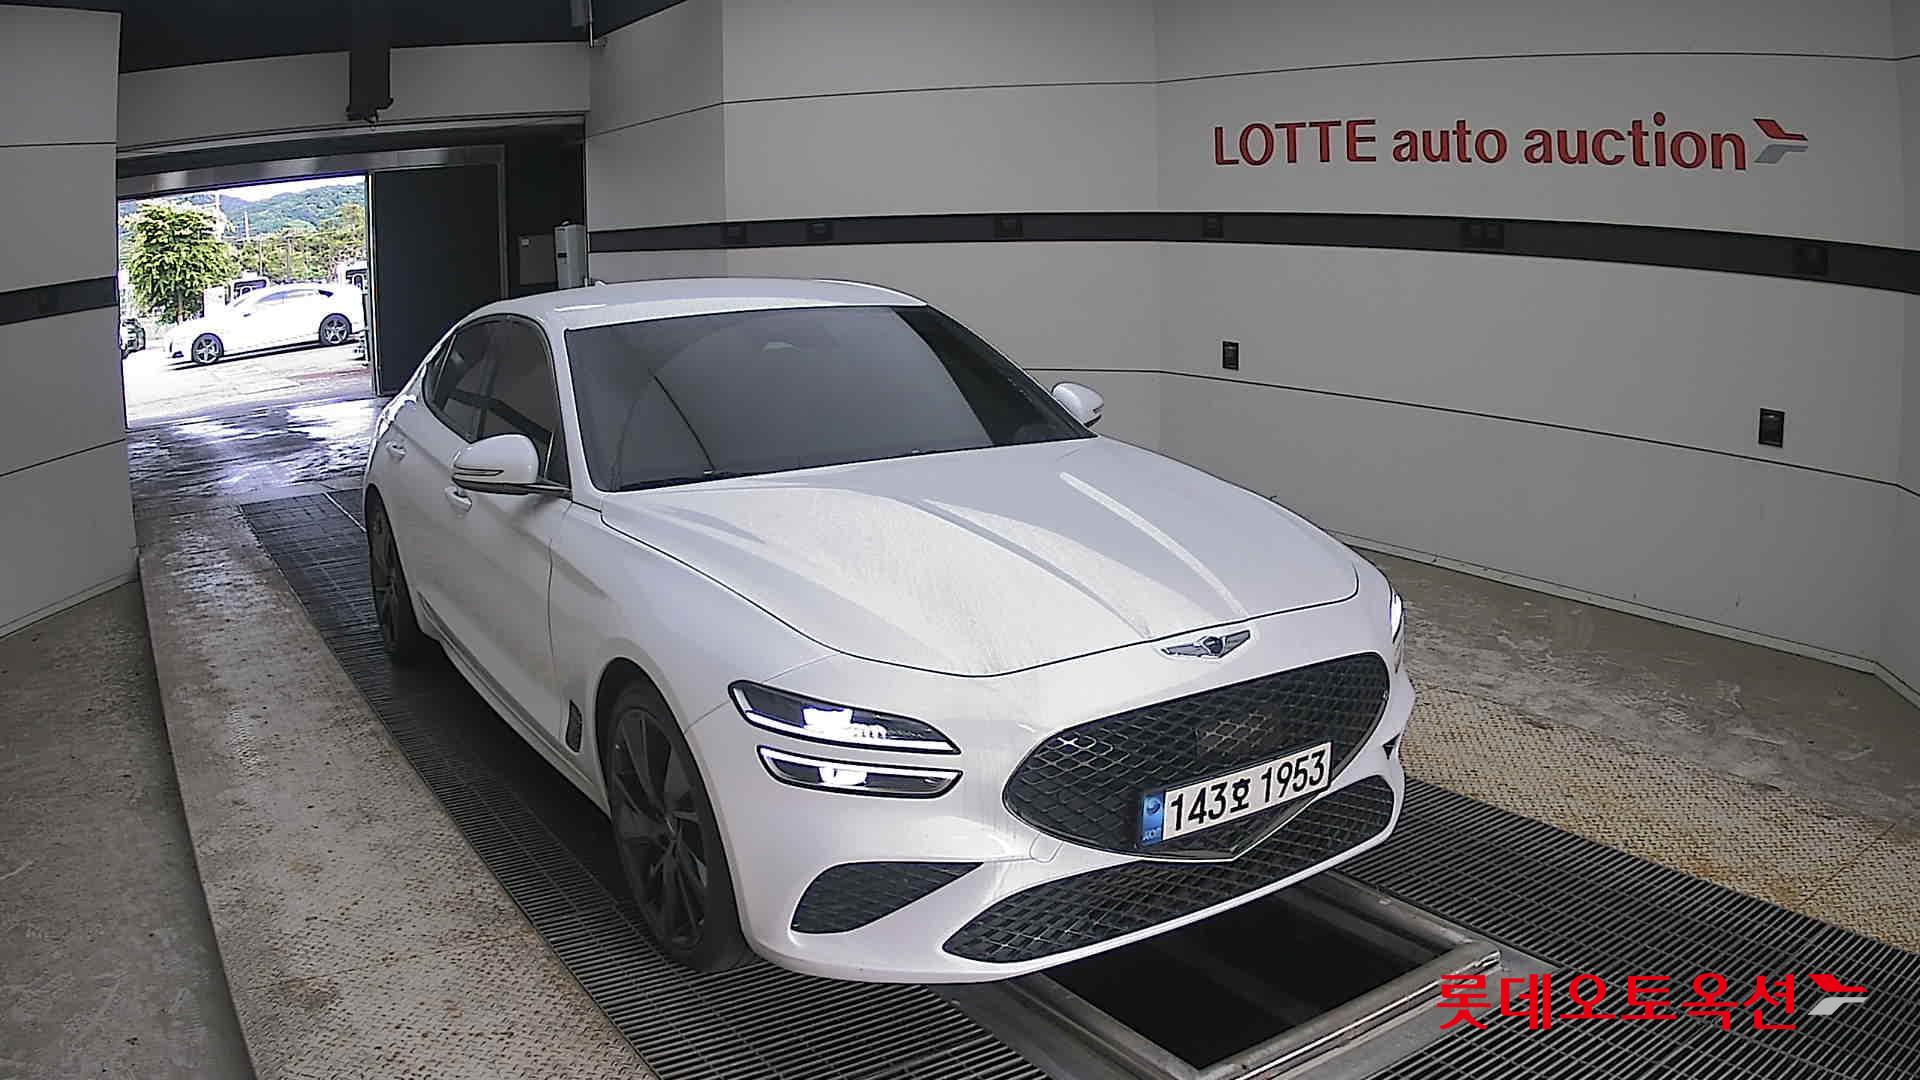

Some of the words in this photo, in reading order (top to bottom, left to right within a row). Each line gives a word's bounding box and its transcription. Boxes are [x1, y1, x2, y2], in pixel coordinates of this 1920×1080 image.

[1213, 119, 1377, 166] LOTTE
[1392, 119, 1508, 164] auto
[1523, 112, 1747, 171] auction
[1170, 778, 1251, 831] 143호
[1261, 750, 1326, 803] 1953
